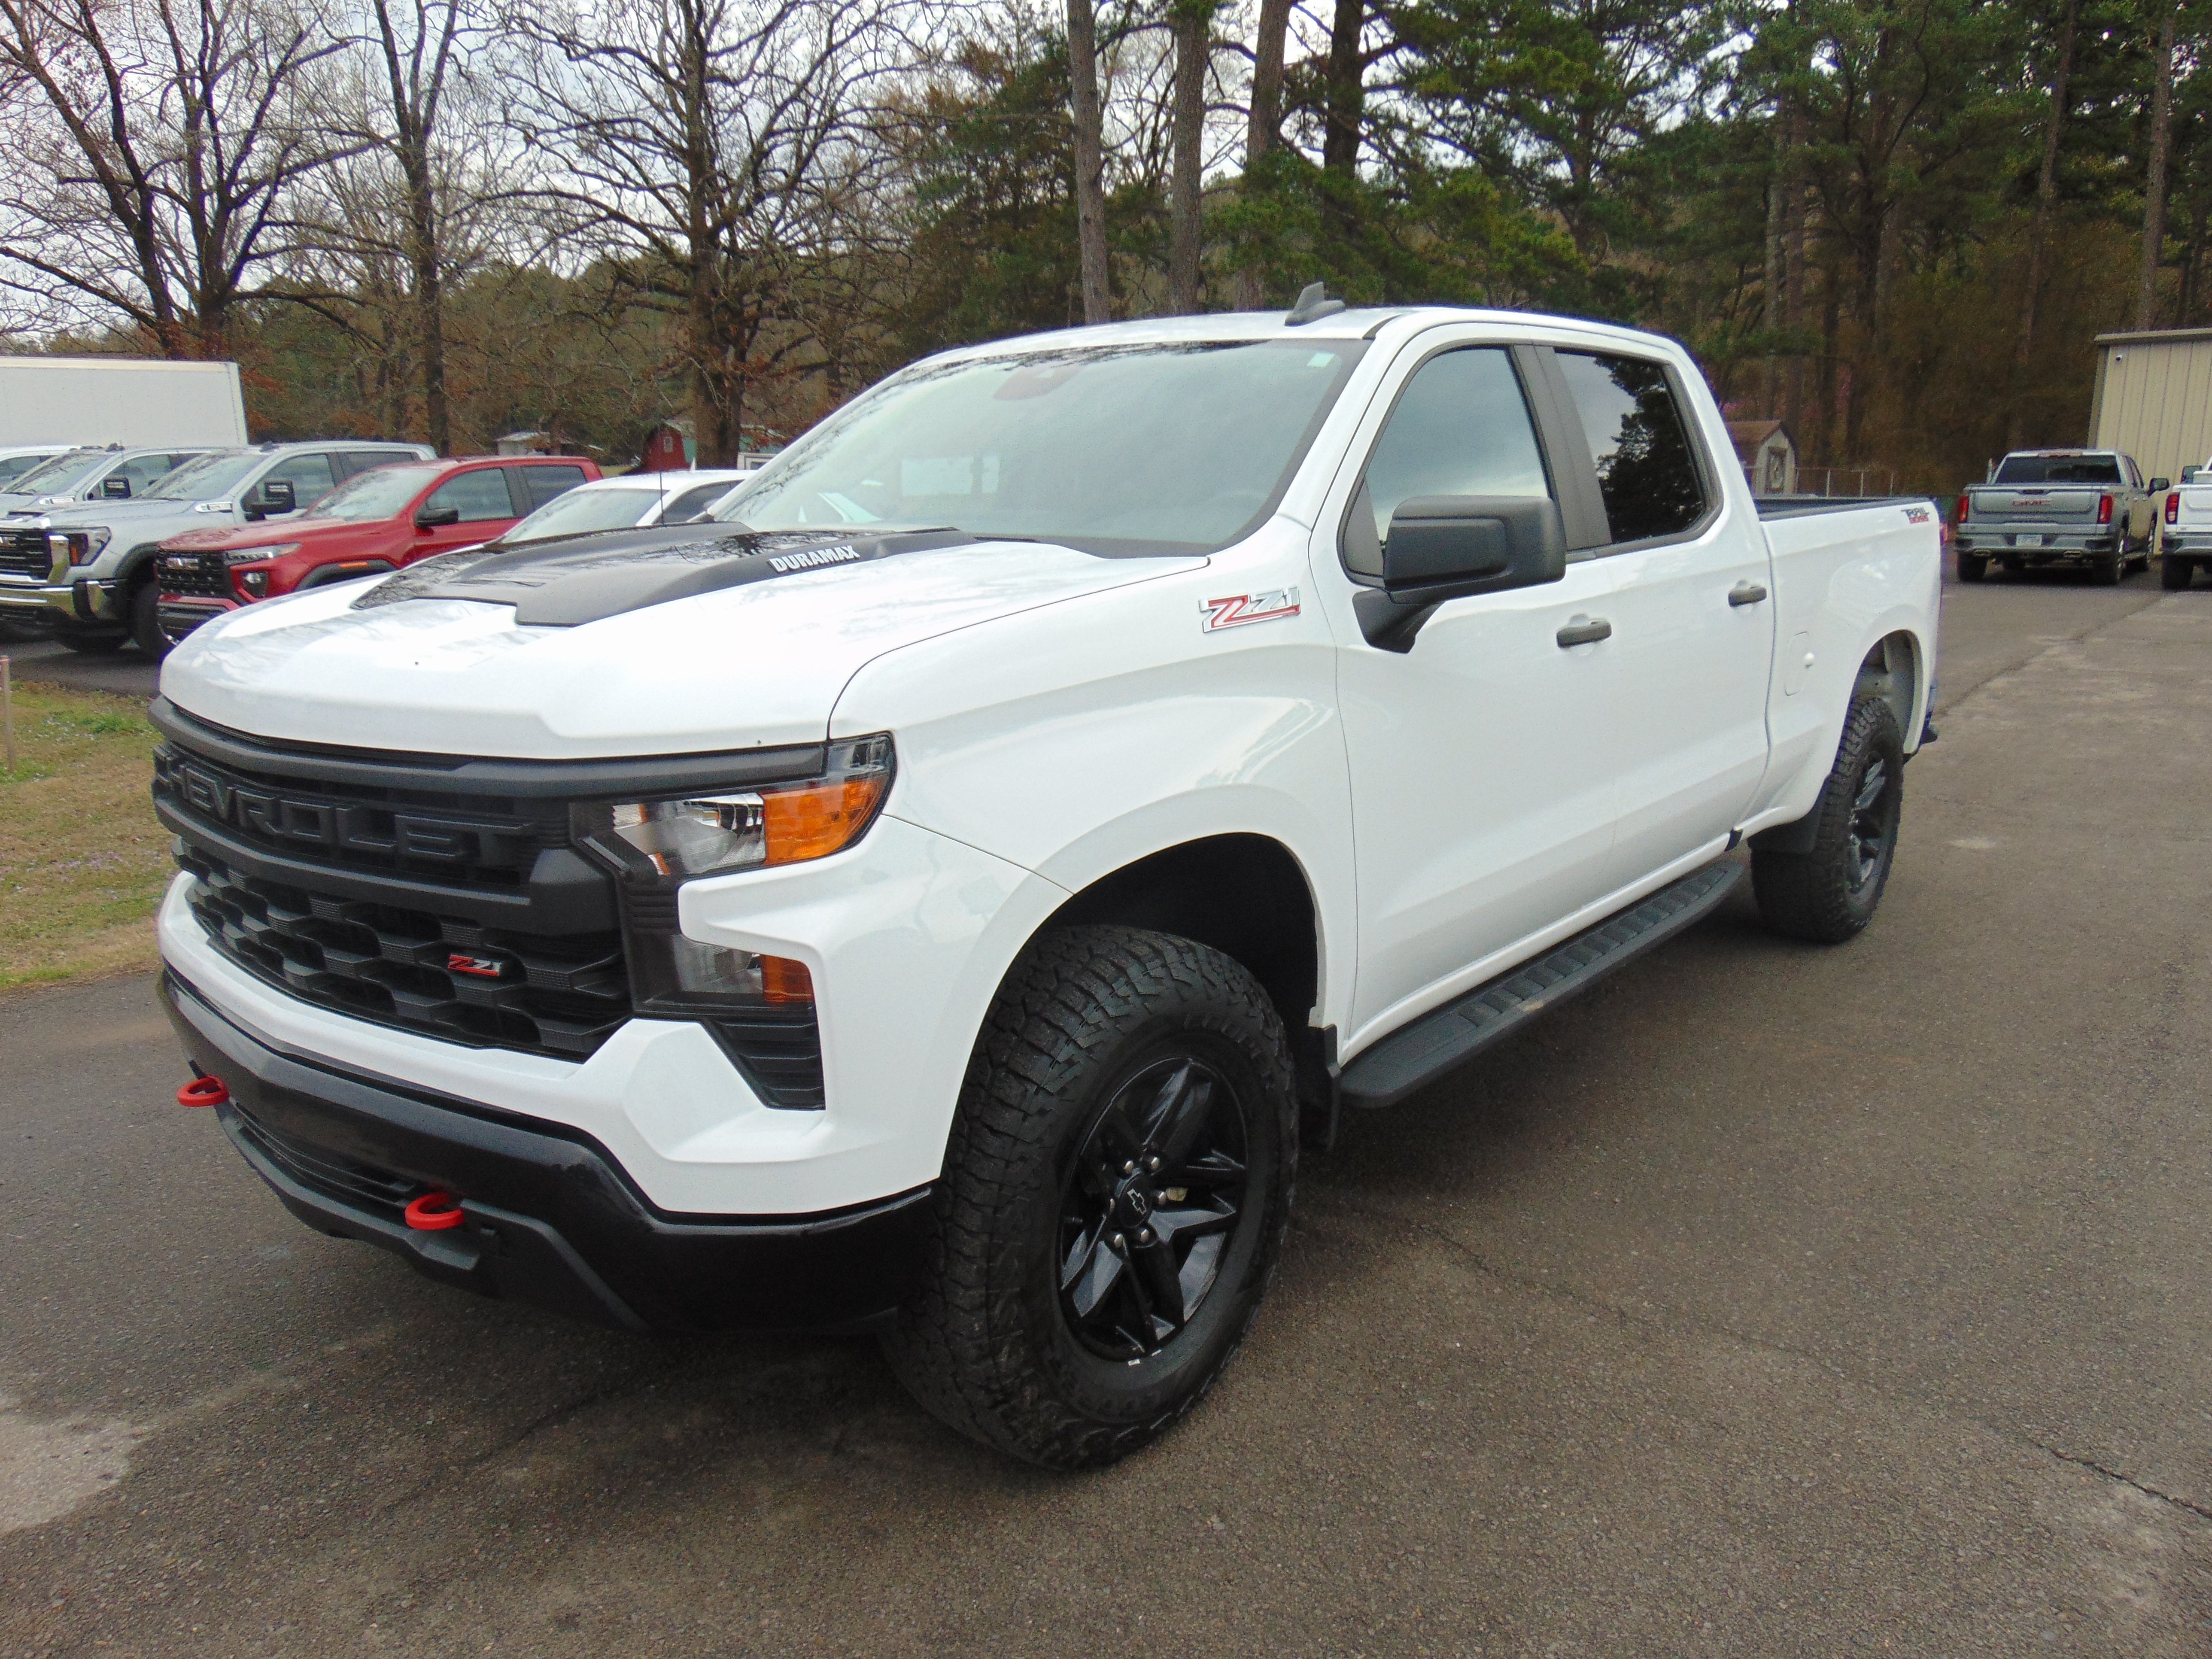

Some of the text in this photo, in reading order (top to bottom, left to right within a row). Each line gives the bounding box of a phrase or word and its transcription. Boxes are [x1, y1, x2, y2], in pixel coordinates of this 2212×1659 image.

[769, 545, 860, 573] DURAMAX
[1199, 587, 1301, 633] Z71
[448, 954, 502, 976] Z71
